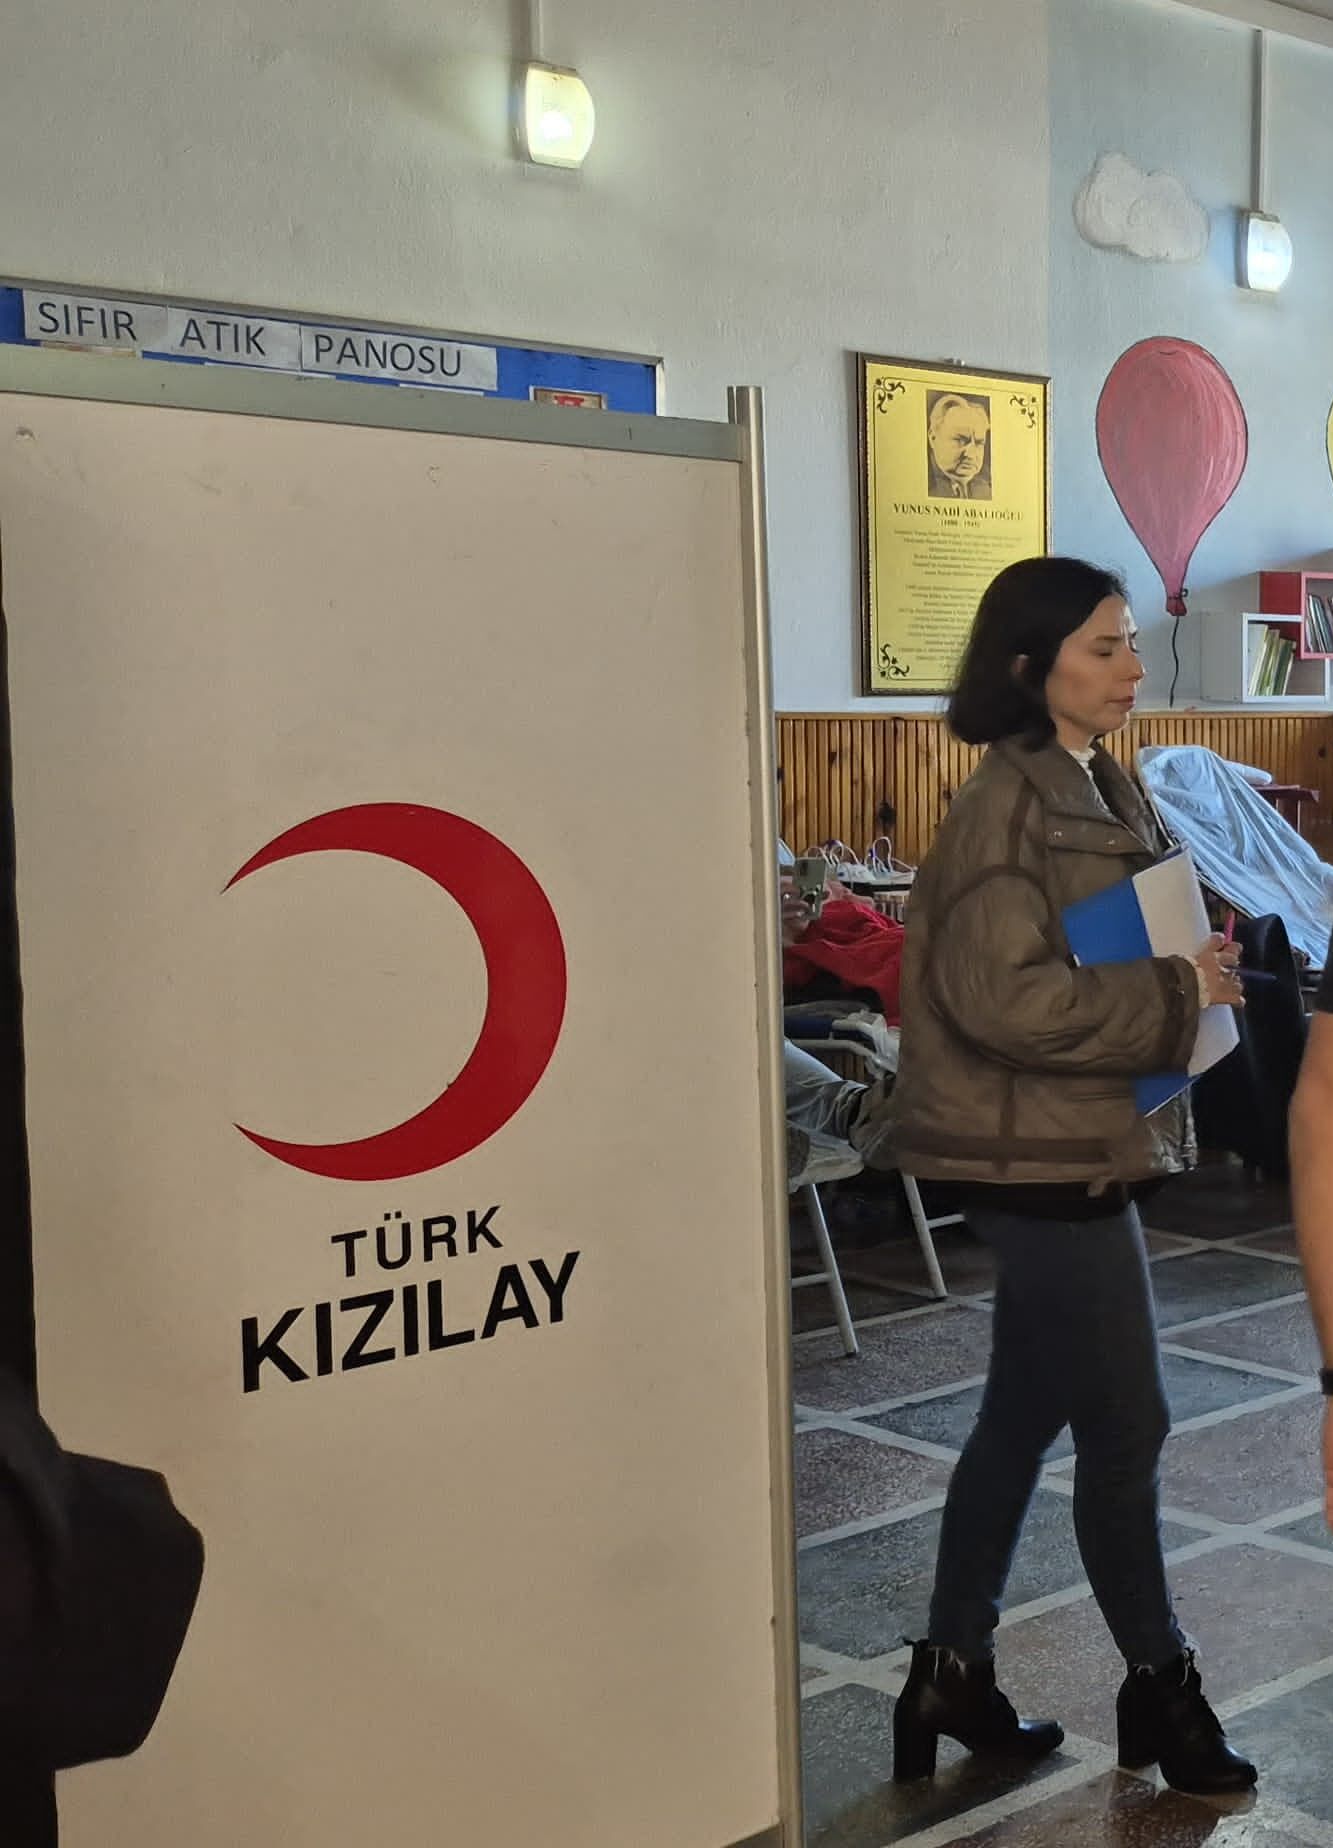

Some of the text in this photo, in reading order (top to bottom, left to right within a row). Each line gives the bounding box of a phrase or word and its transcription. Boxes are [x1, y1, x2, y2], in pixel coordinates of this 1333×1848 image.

[37, 302, 463, 378] SIFIR ATIK PANOSU
[893, 503, 931, 515] YUNUS
[331, 1205, 504, 1278] TÜRK
[241, 1250, 581, 1394] KIZILAY
